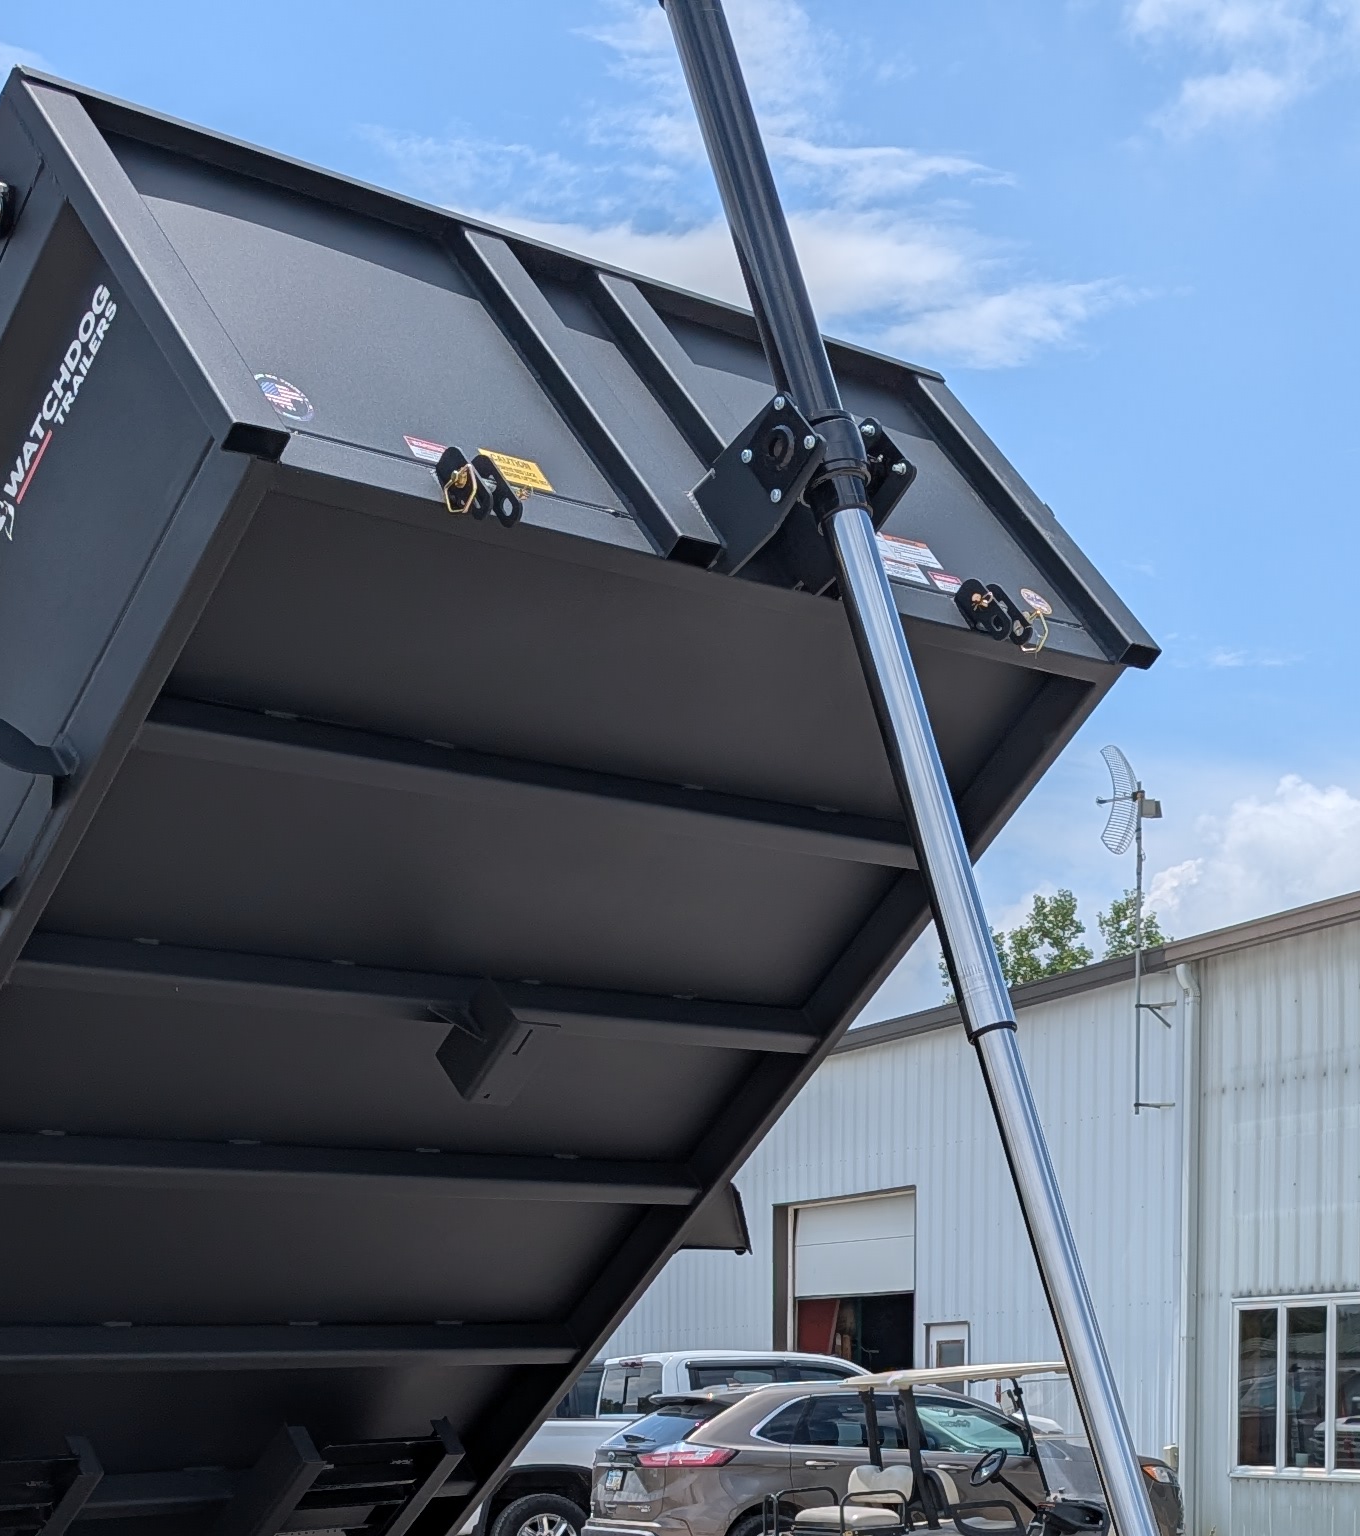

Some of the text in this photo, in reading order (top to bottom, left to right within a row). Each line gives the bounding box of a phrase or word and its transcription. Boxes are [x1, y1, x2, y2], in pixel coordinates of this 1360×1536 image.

[4, 283, 111, 497] WATCHDOG
[53, 300, 117, 425] TRAILERS
[490, 453, 532, 470] CAUTION
